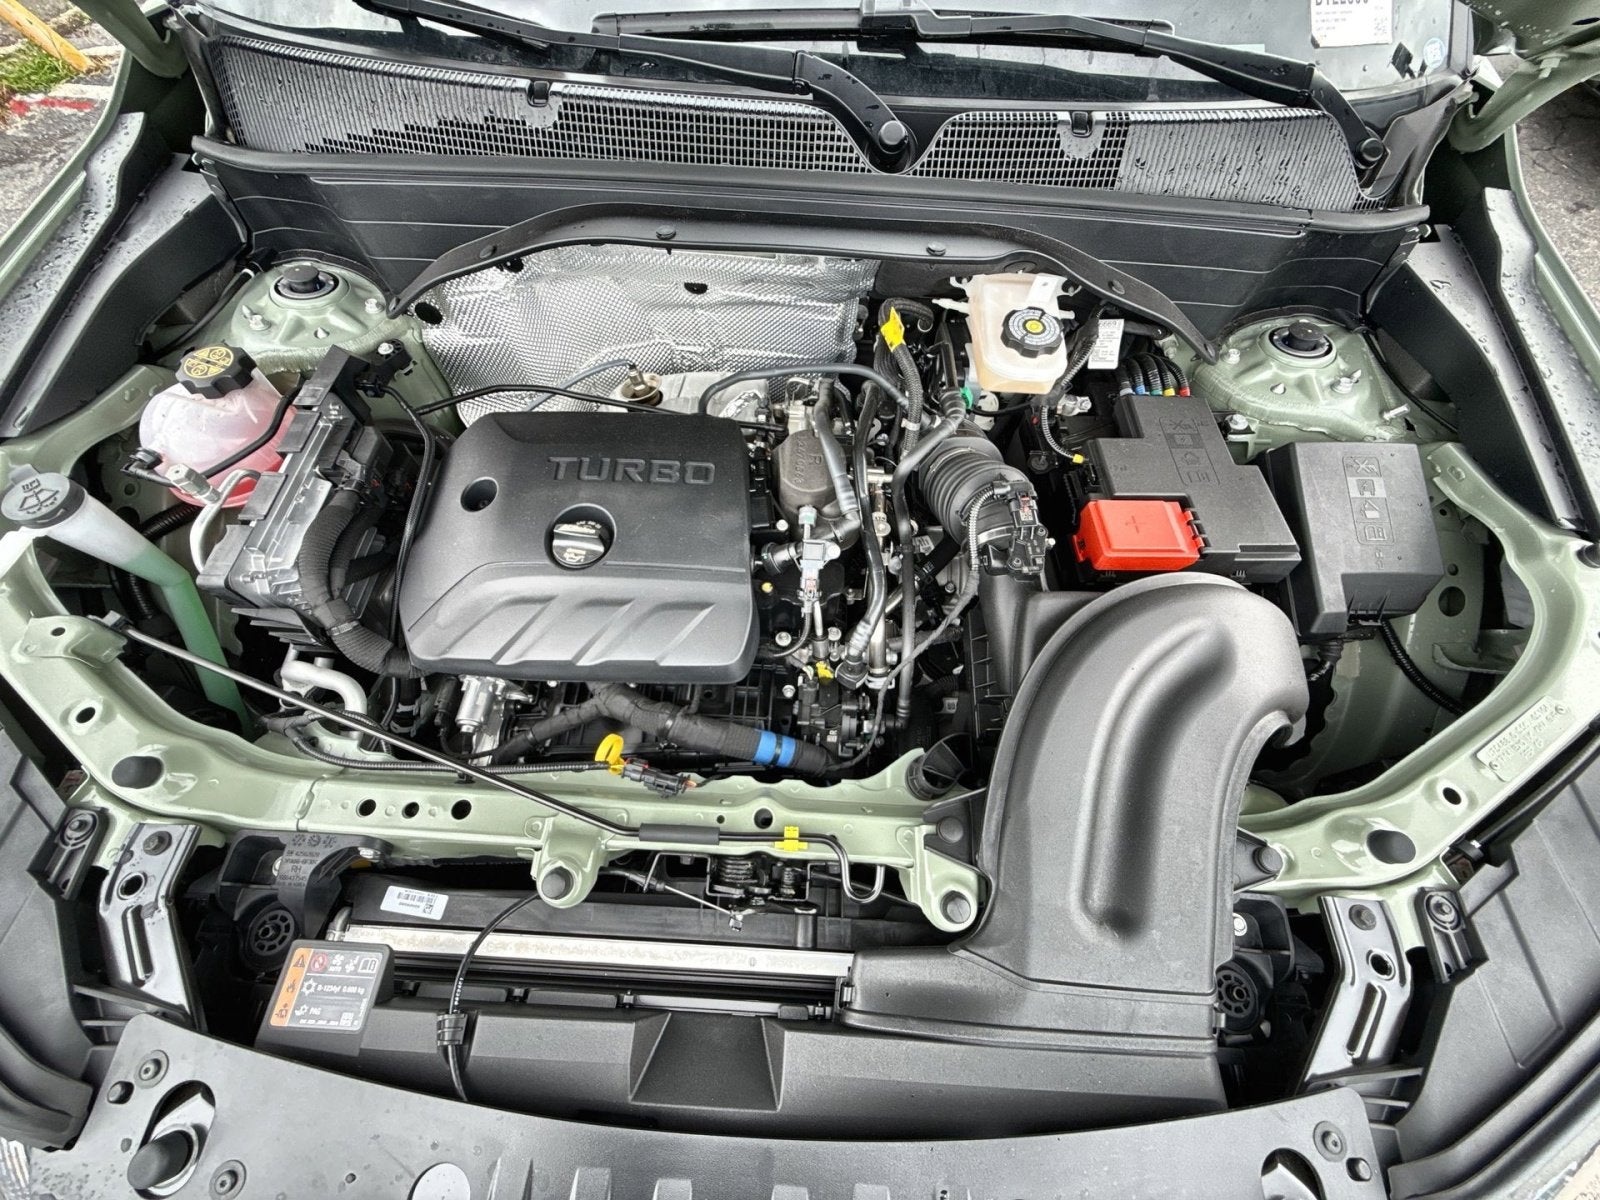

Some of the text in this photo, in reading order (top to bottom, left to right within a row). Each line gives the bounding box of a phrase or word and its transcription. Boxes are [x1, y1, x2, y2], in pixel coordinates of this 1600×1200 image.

[549, 456, 716, 485] TURBO
[291, 865, 302, 873] RH
[358, 986, 365, 994] kg
